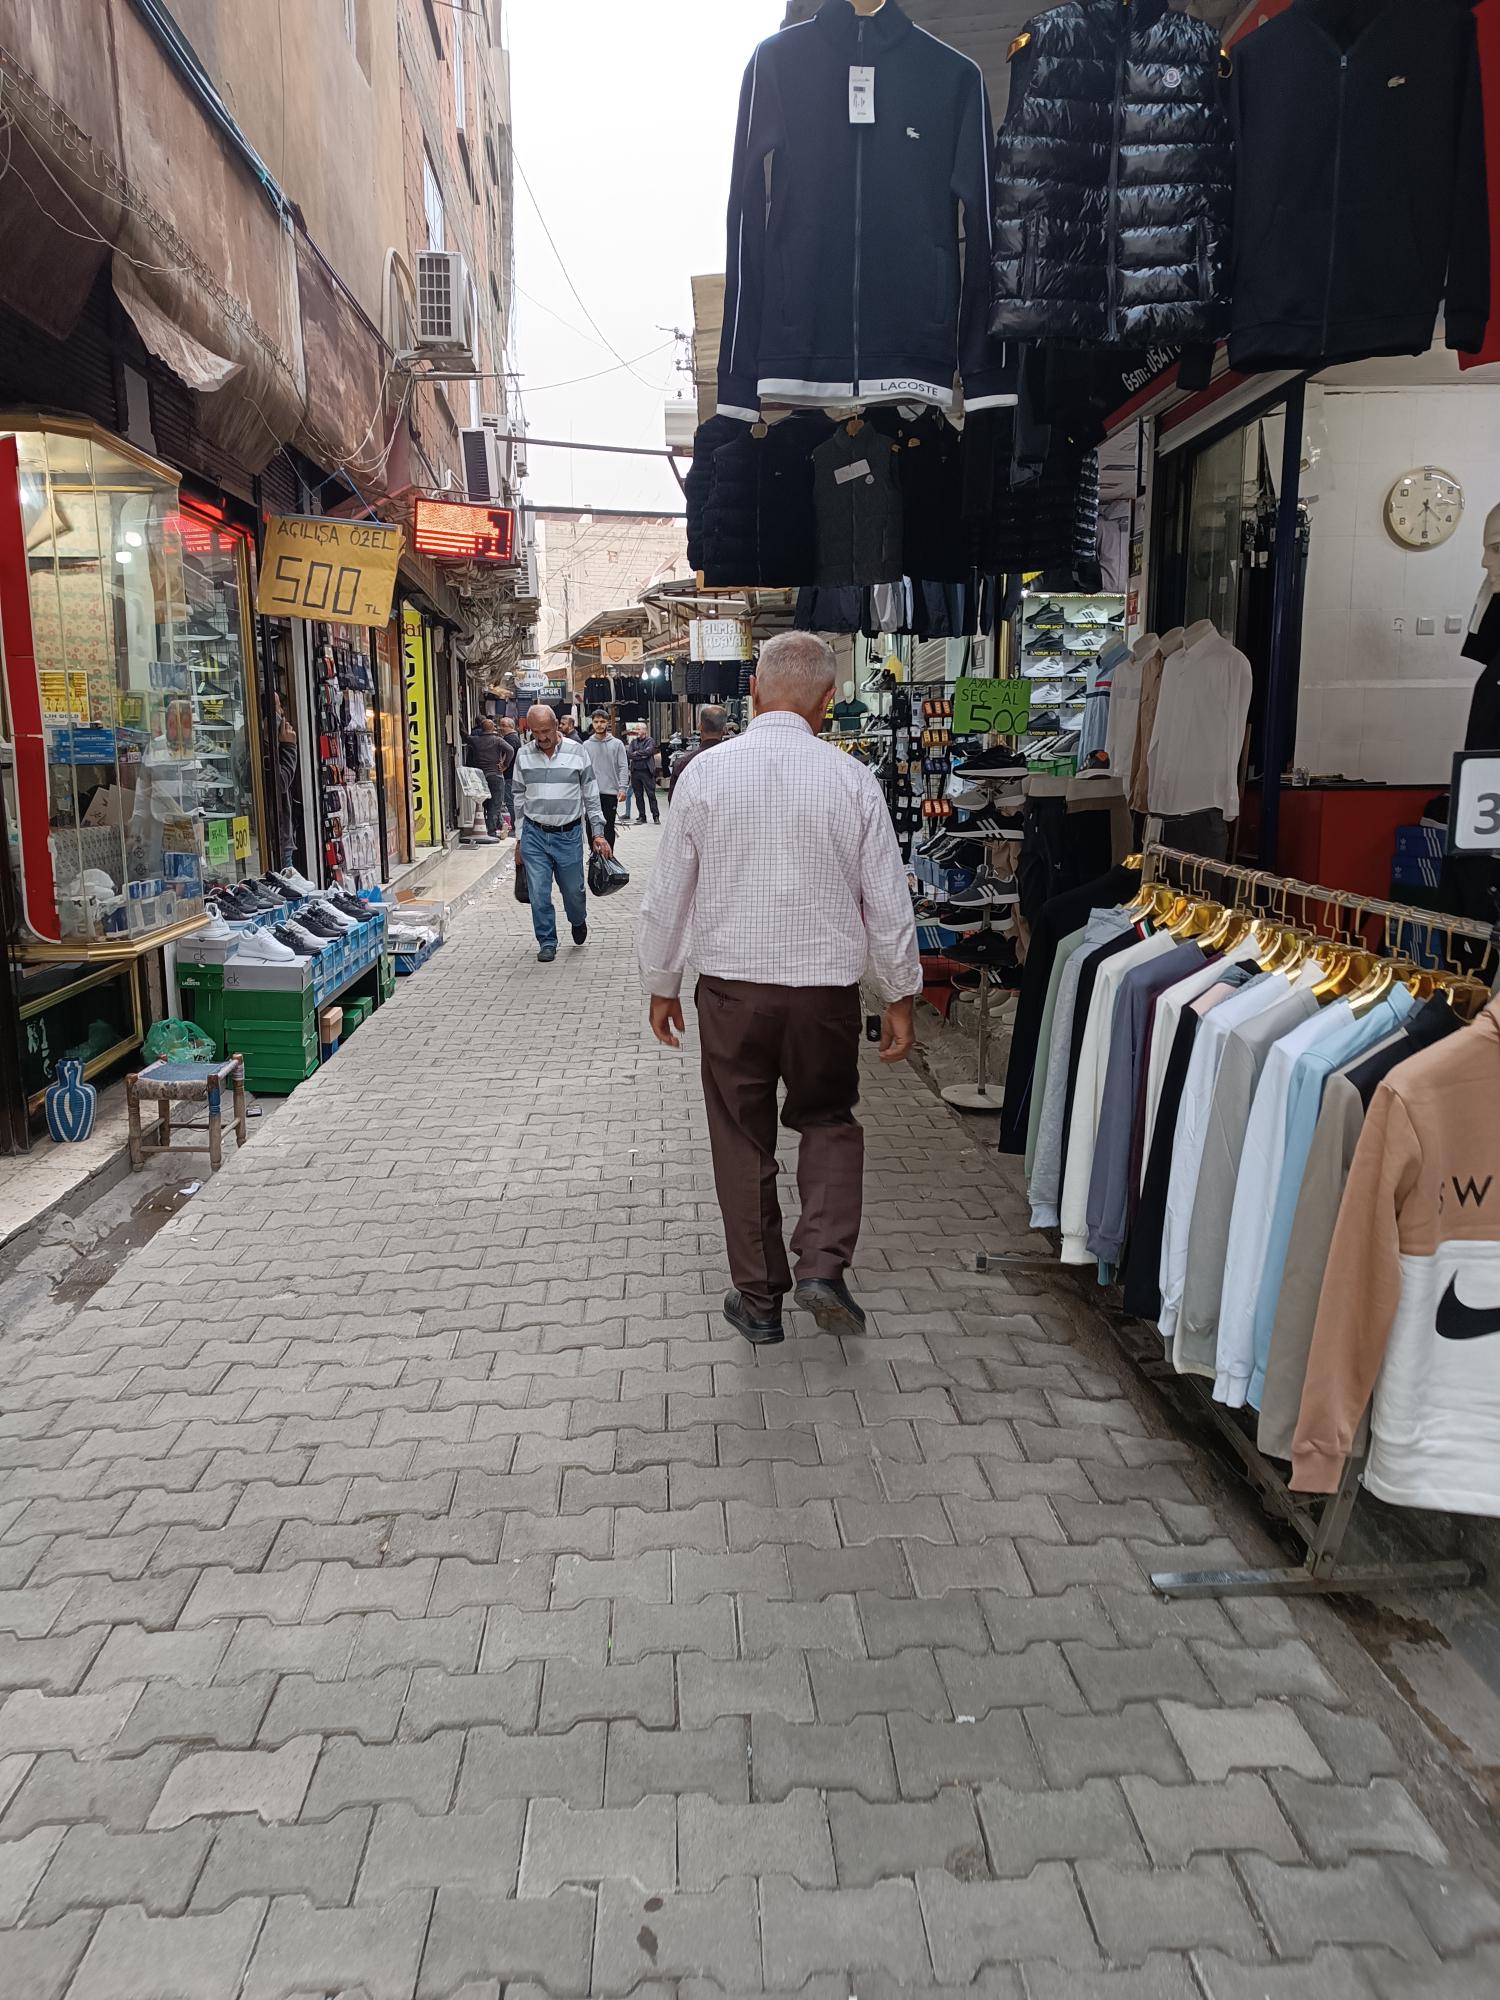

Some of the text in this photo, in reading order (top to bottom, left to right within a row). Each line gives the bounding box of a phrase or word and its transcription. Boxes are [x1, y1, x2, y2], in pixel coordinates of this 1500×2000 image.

[880, 381, 938, 396] LACOSTE
[277, 521, 394, 550] AÇILIŞA ÖZEL
[271, 555, 361, 615] 500
[365, 603, 381, 615] TL
[969, 705, 1029, 734] 500
[235, 829, 248, 850] 500
[226, 970, 240, 985] ck
